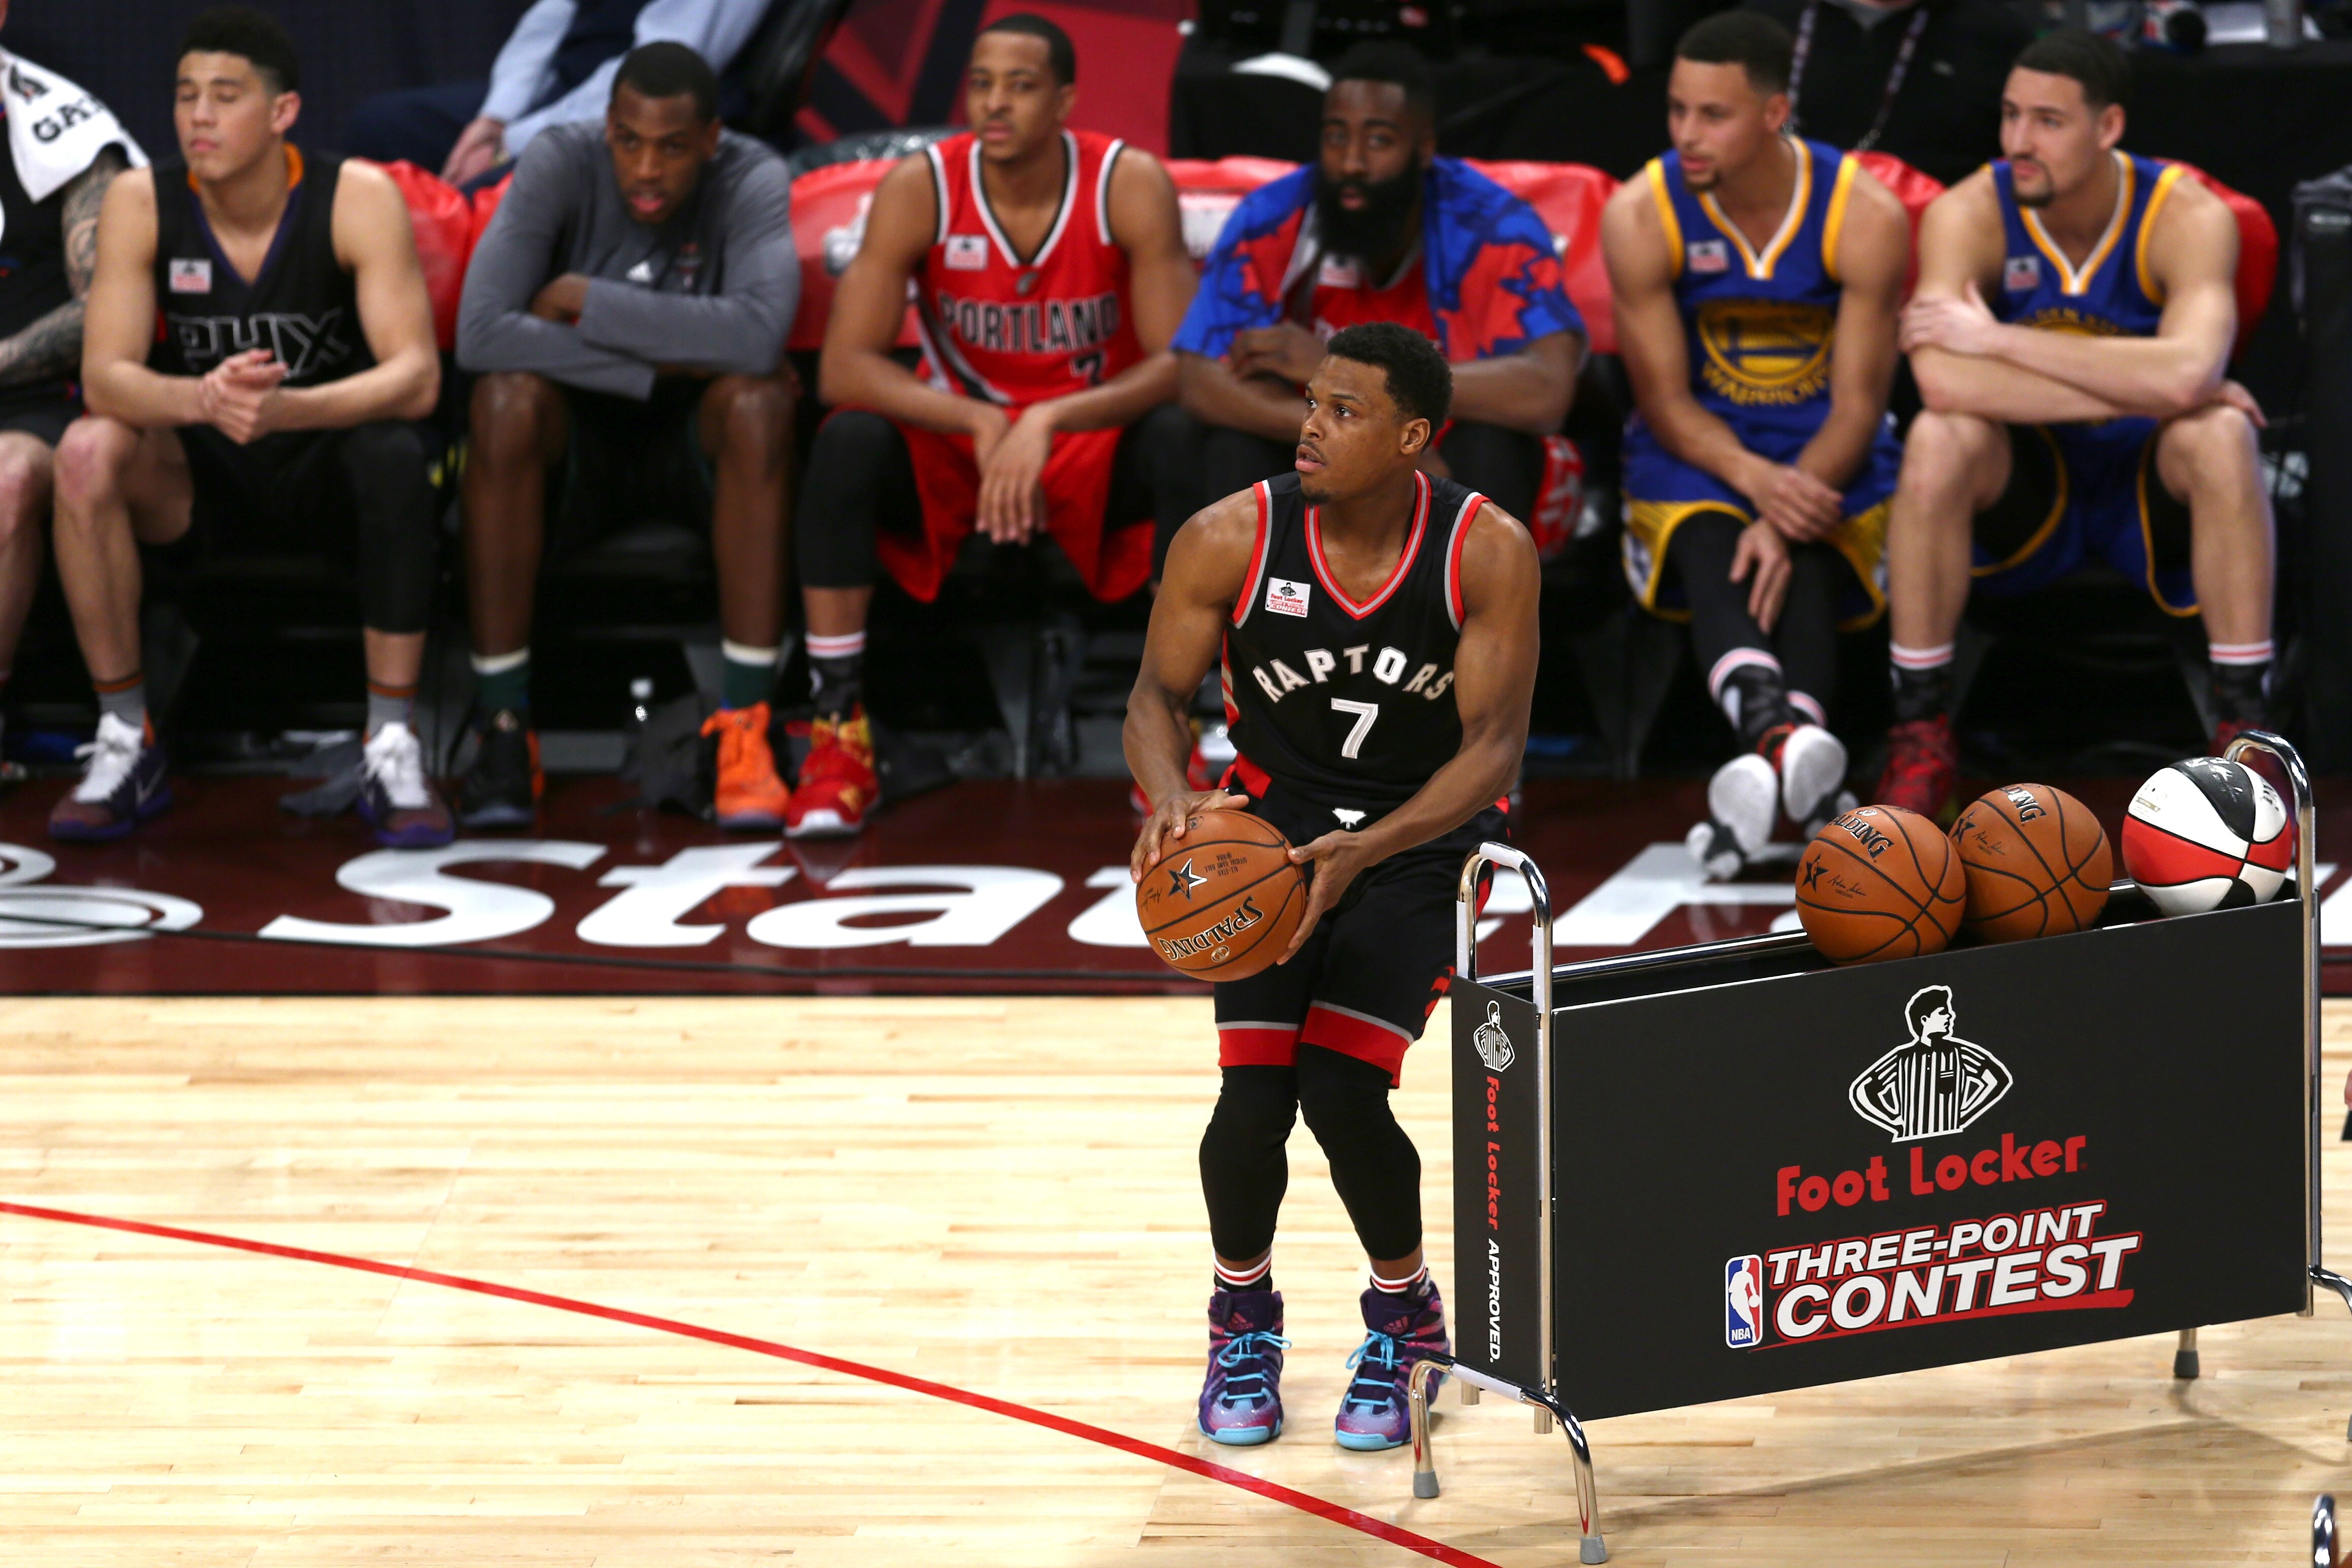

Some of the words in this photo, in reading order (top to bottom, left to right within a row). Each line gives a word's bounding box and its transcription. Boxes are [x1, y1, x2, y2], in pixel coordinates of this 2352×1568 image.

[166, 307, 352, 378] PHX
[937, 290, 1120, 354] PORTLAND
[1253, 643, 1454, 704] RAPTORS
[1331, 698, 1378, 759] 7
[1156, 895, 1264, 961] SPALDING
[1486, 1076, 1500, 1132] Foot
[1488, 1141, 1501, 1230] Locker
[1777, 1156, 1890, 1216] Foot
[1768, 1204, 2104, 1285] THREE-POINT
[1489, 1238, 1501, 1363] APPROVED.
[1776, 1235, 2139, 1338] CONTEST
[1731, 1328, 1751, 1341] NBA
